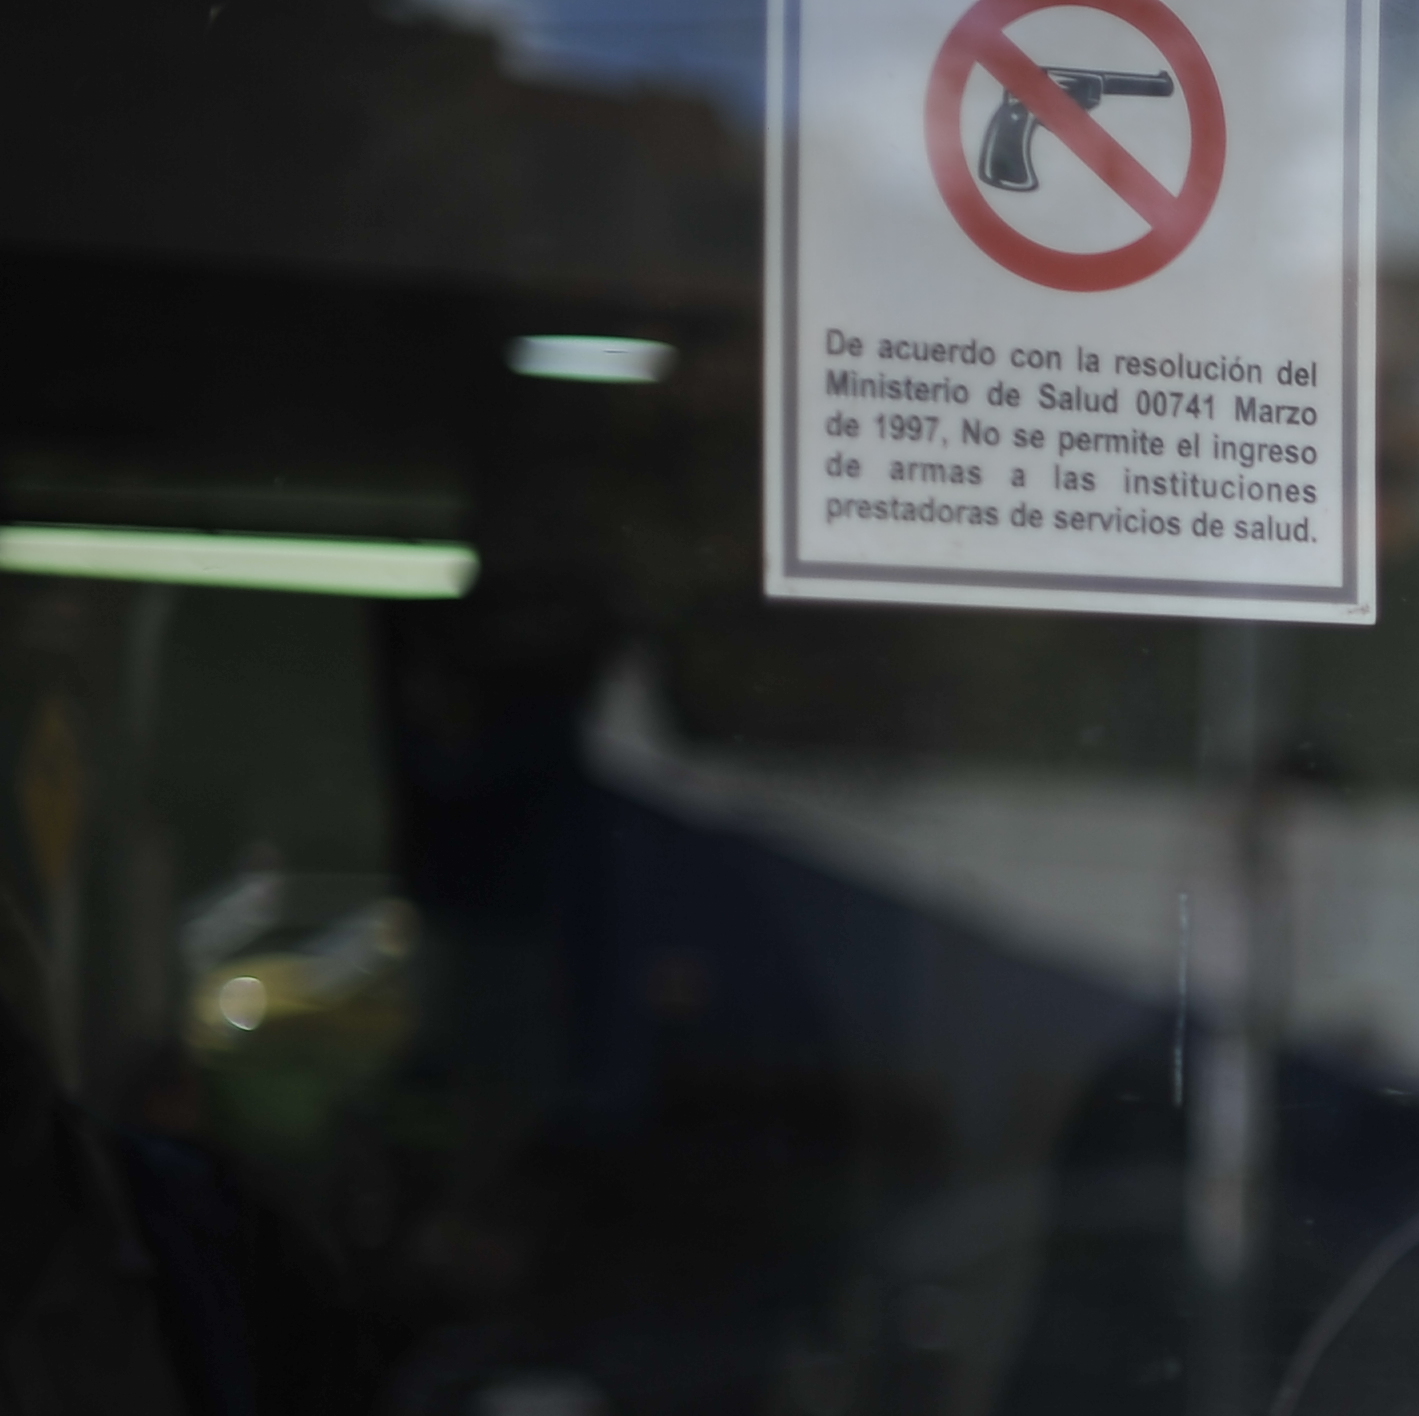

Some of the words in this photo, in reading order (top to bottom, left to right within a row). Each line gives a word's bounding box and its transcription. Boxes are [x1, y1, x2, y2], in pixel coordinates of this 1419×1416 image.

[825, 327, 865, 358] De
[877, 338, 997, 367] acuerdo
[1009, 347, 1063, 371] con
[1076, 345, 1101, 374] la
[1114, 352, 1263, 385] resolución
[1276, 359, 1318, 388] del
[825, 368, 971, 405] Ministerio
[986, 379, 1022, 409] de
[1038, 381, 1119, 415] Salud
[1135, 388, 1215, 421] 00741
[1234, 395, 1319, 427] Marzo
[824, 409, 861, 439] de
[874, 412, 948, 447] 1997,
[961, 417, 1002, 447] No
[1012, 427, 1046, 450] se
[1057, 427, 1166, 458] permite
[1175, 431, 1201, 459] el
[1212, 433, 1319, 470] ingreso
[824, 451, 863, 479] de
[888, 459, 984, 486] armas
[1009, 466, 1027, 489] a
[1053, 463, 1097, 493] las
[1123, 467, 1318, 505] instituciones
[825, 496, 1000, 527] prestadoras
[1009, 501, 1045, 529] de
[1052, 506, 1183, 537] servicios
[1190, 510, 1225, 539] de
[1233, 514, 1318, 544] salud.
